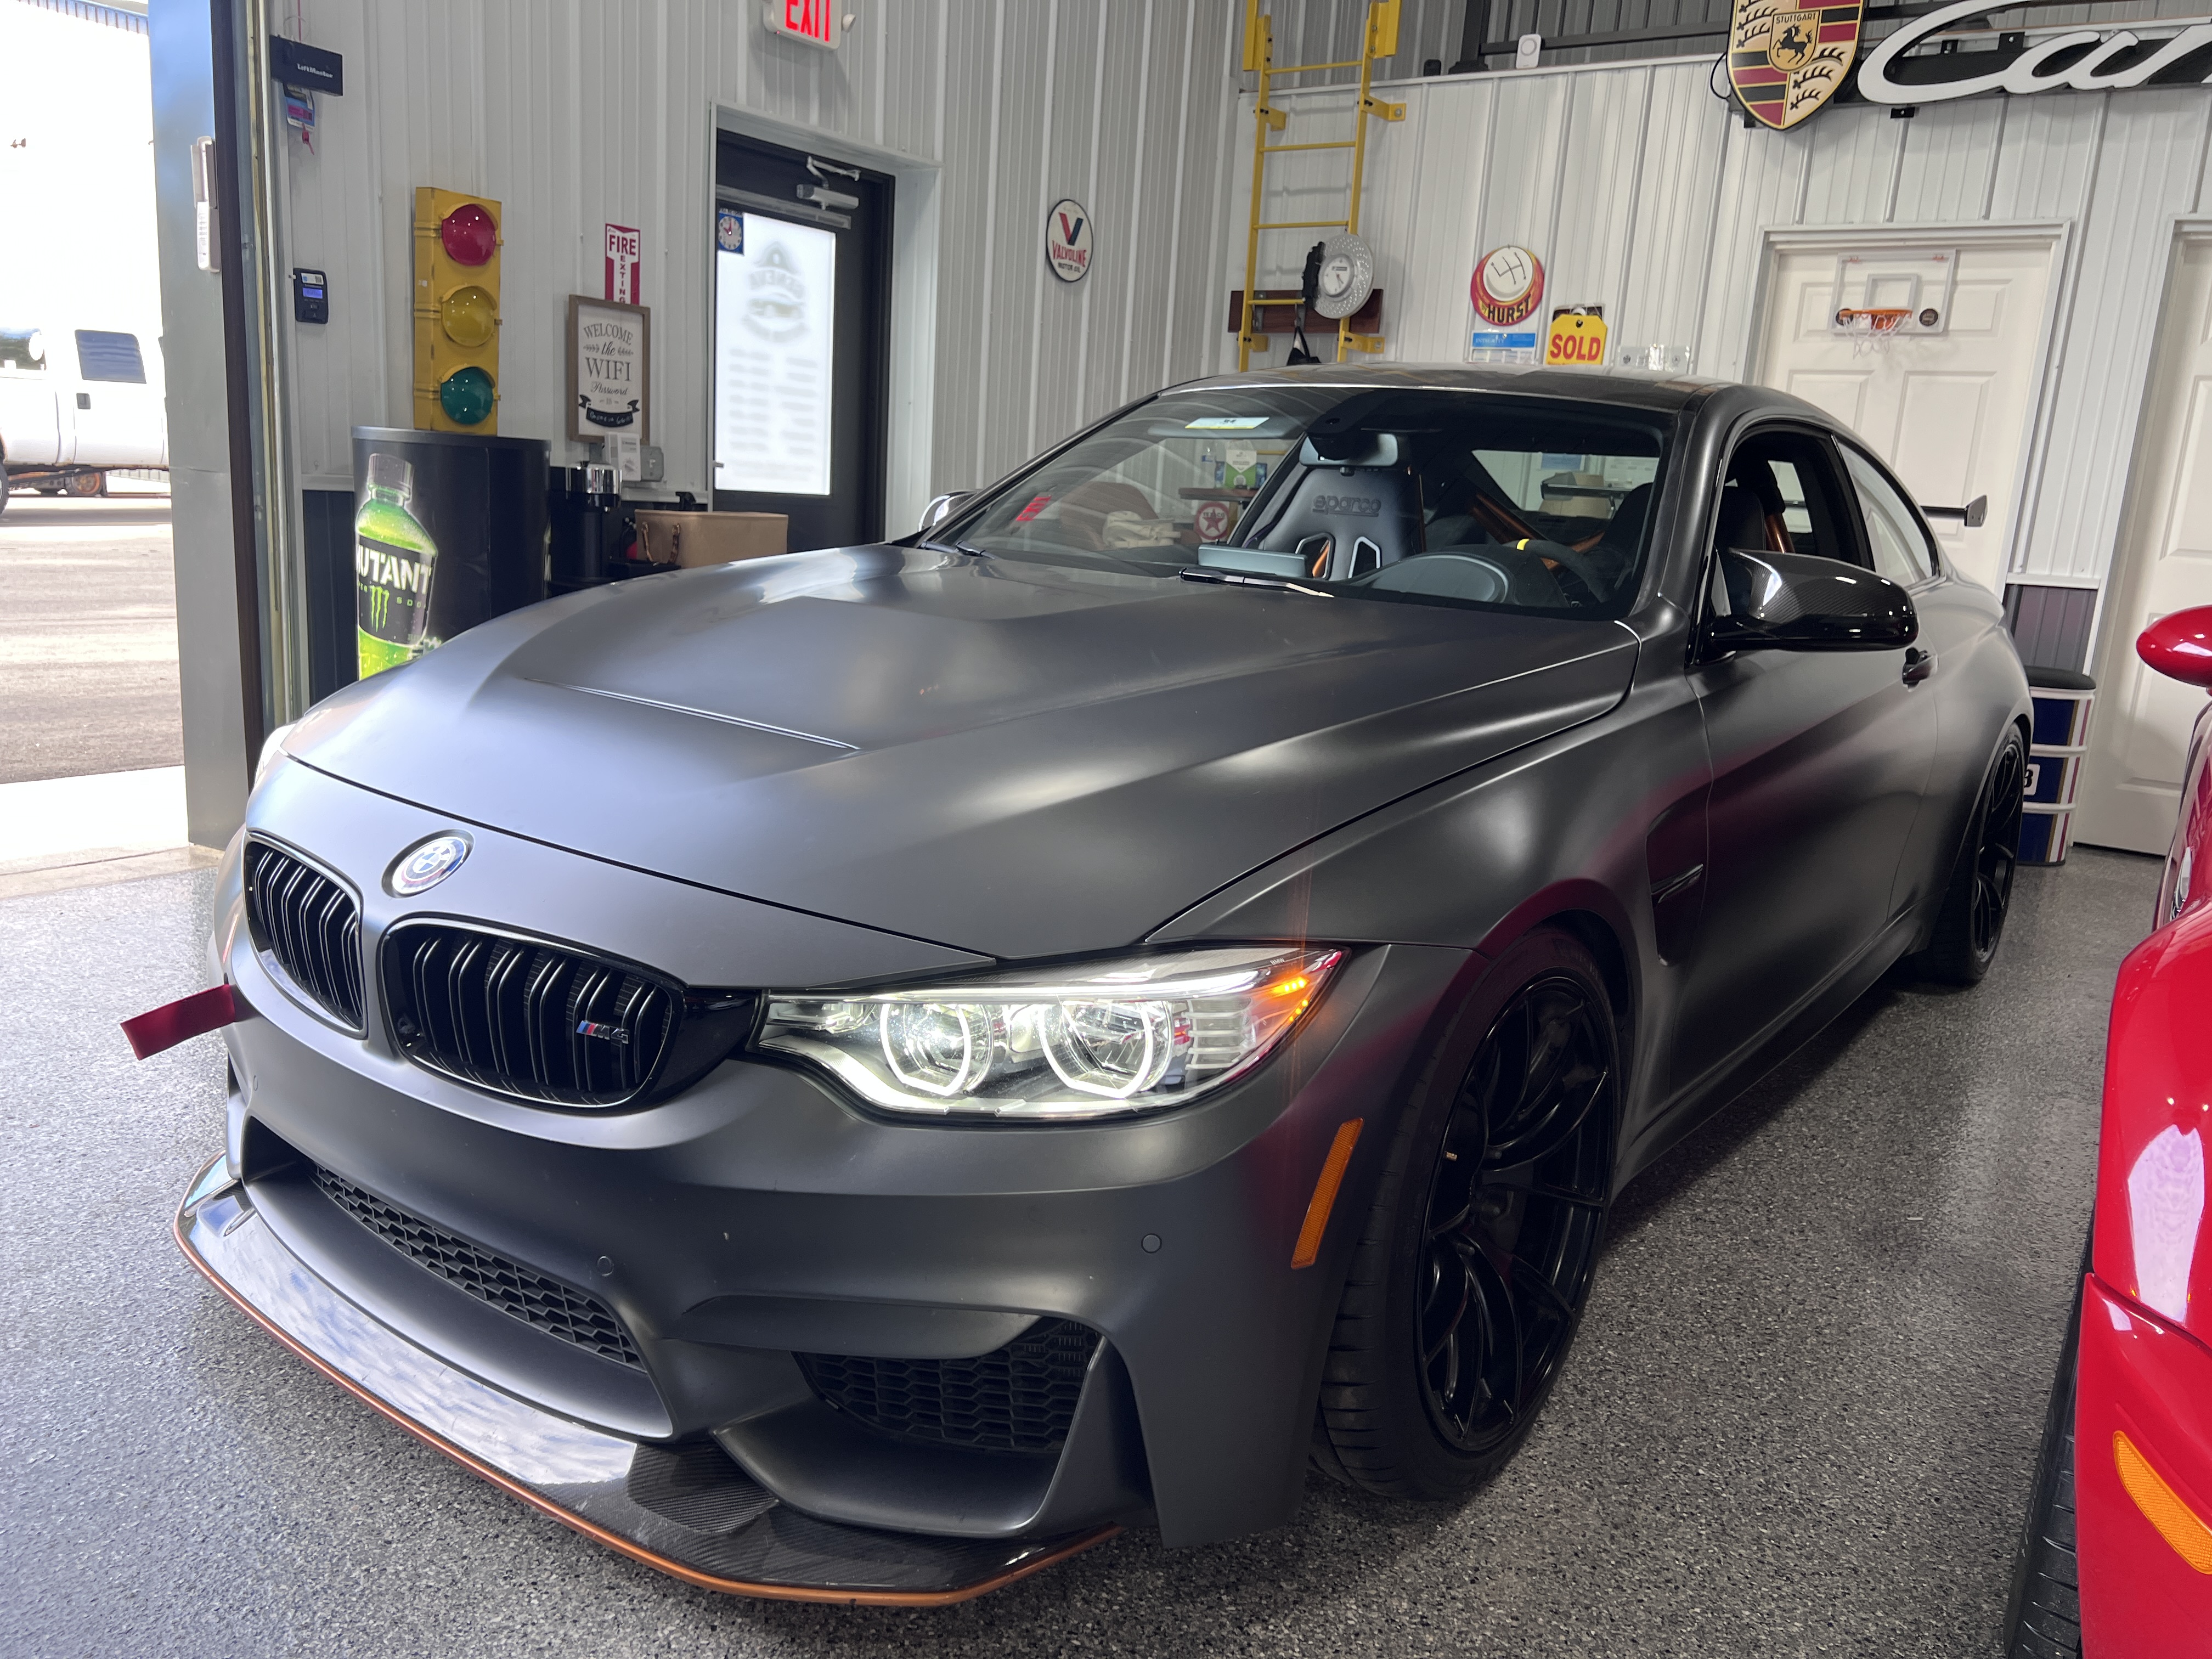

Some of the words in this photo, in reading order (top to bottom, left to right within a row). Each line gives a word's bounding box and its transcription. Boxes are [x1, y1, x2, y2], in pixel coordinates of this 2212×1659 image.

[1776, 12, 1816, 24] STUTTGART
[297, 63, 334, 78] LiftMaster
[609, 234, 636, 256] FIRE
[1052, 240, 1087, 268] VALVOLINE
[1058, 262, 1073, 272] MOTOR
[1487, 293, 1531, 323] HURST
[583, 323, 634, 346] WELCOME
[601, 341, 616, 357] the
[1549, 333, 1601, 361] SOLD
[585, 356, 631, 382] WIFI
[591, 381, 628, 395] Password
[1312, 494, 1381, 516] sparco
[1269, 957, 1285, 966] BMW
[590, 1023, 630, 1045] M4
